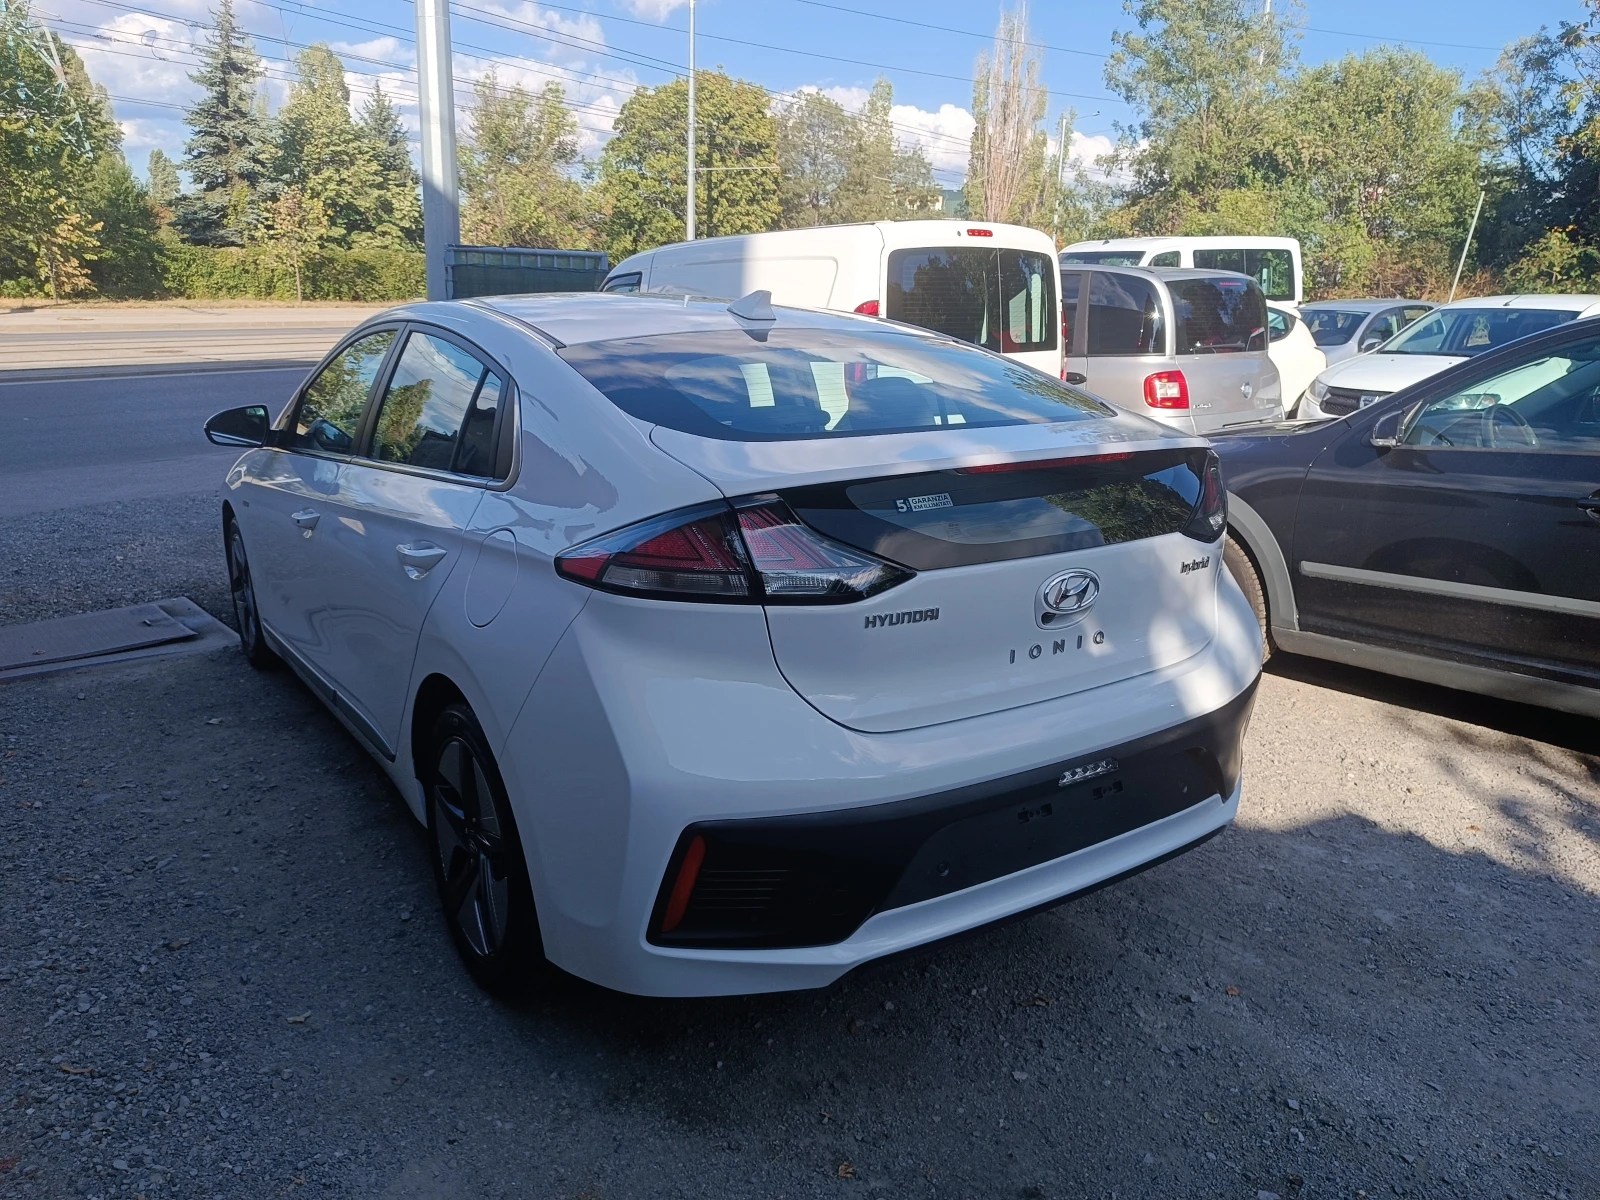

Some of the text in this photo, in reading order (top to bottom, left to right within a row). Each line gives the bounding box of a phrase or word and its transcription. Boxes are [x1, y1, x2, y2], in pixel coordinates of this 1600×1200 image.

[896, 499, 907, 512] 5
[911, 494, 949, 504] GARANZIA
[1180, 556, 1210, 575] hybrid
[864, 607, 940, 629] HYUNDAI
[1009, 630, 1105, 664] IONIQ
